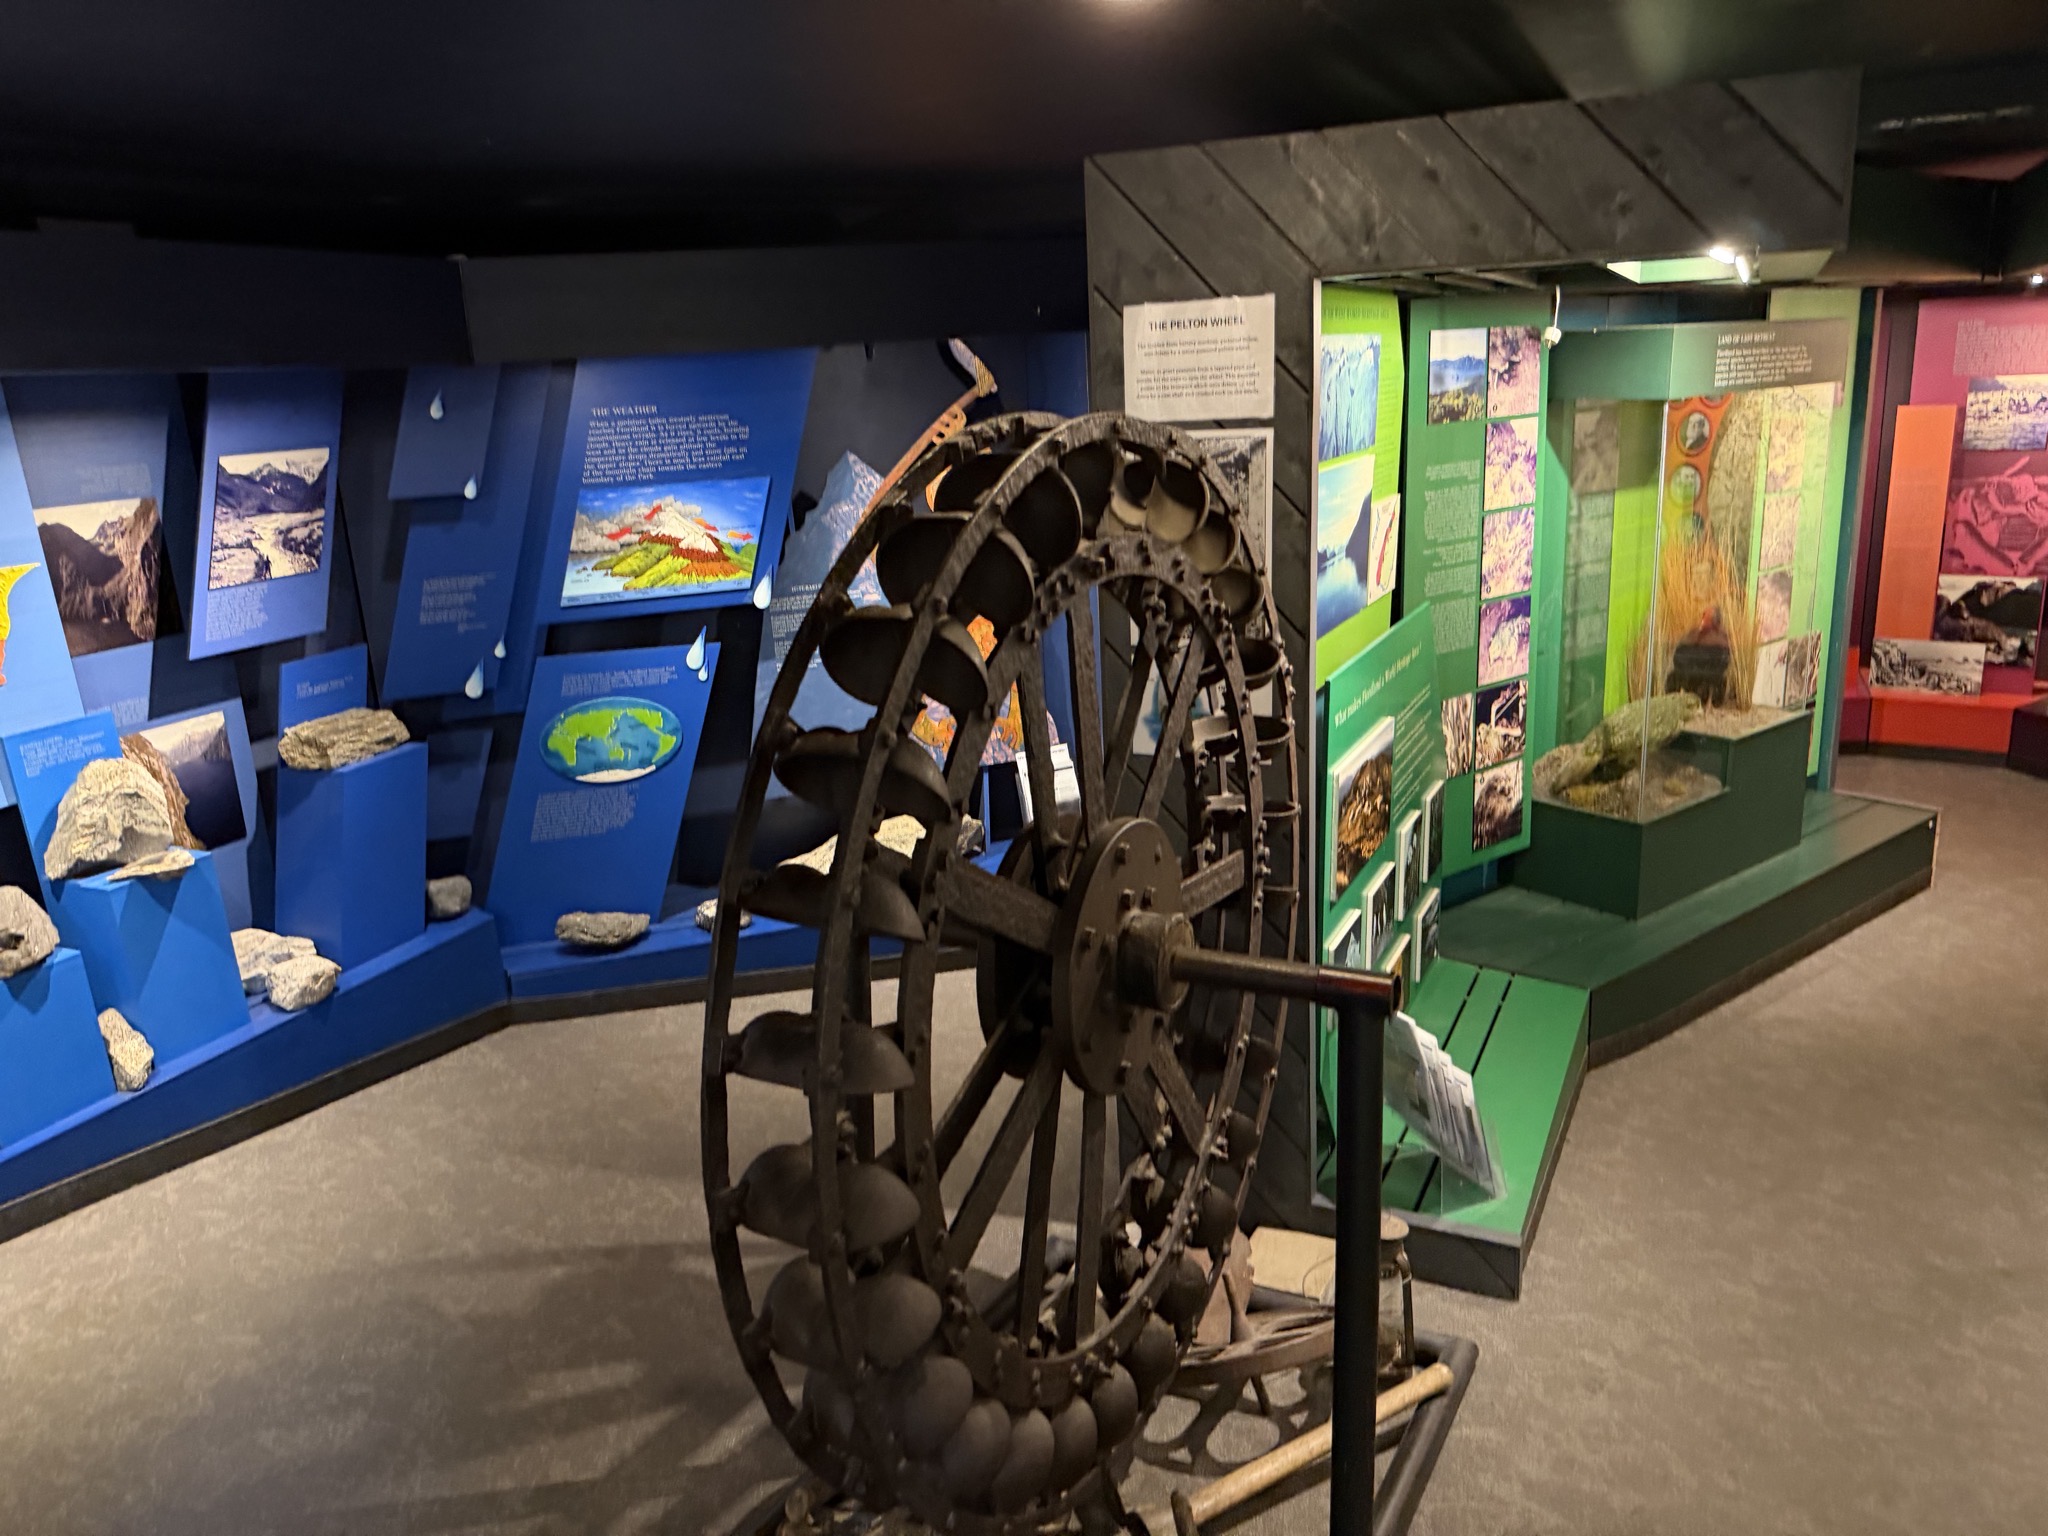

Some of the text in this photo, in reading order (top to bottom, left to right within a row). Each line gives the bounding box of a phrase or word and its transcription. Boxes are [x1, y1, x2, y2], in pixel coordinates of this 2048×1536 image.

[1148, 315, 1245, 332] THE PELTON WHEEL
[1718, 334, 1732, 346] LAND
[591, 404, 658, 418] THE WEATHER
[616, 425, 649, 434] Fiordland
[1362, 674, 1382, 706] Fiordland
